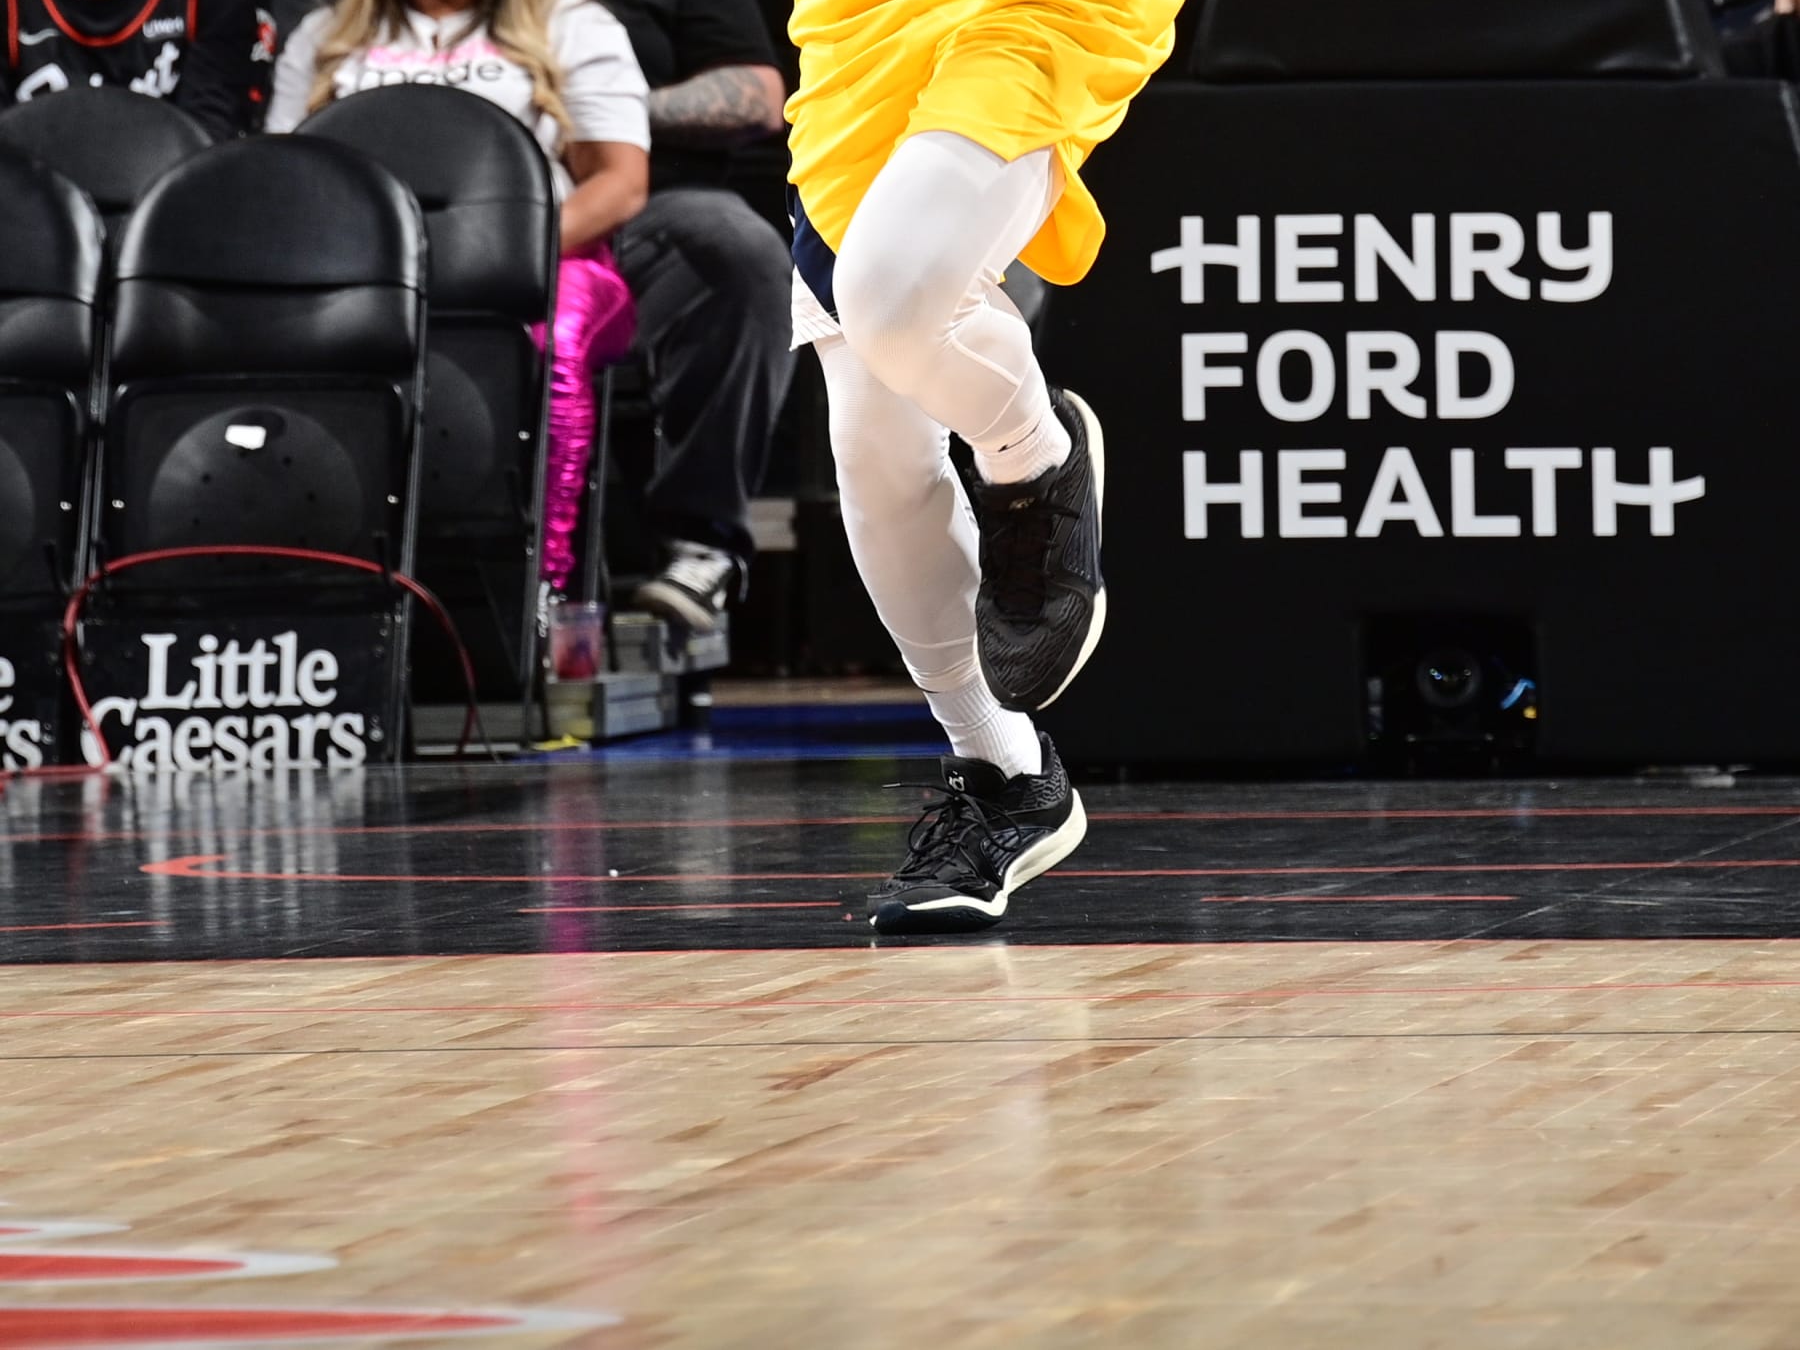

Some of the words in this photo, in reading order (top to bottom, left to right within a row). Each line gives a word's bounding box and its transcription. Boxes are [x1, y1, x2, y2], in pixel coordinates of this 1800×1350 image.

[1151, 211, 1613, 303] HENRY
[1181, 329, 1515, 422] FORD
[1182, 446, 1706, 540] HEALTH
[139, 630, 339, 710] Little
[80, 696, 367, 773] Caesars
